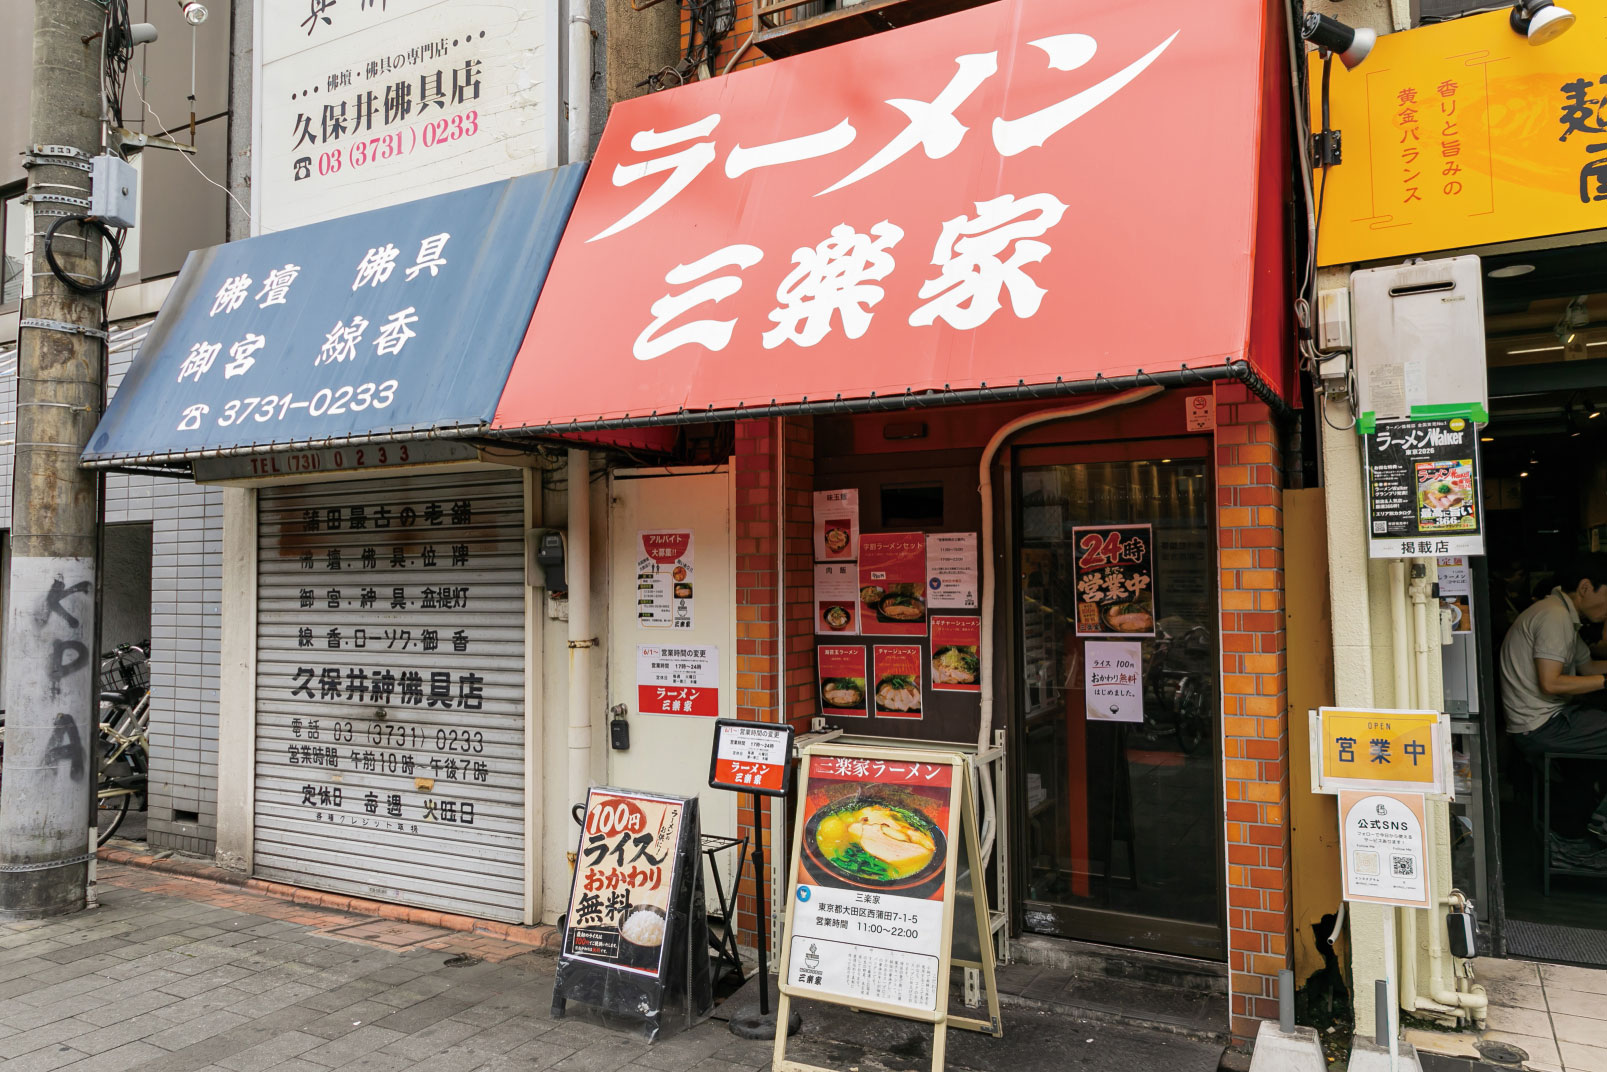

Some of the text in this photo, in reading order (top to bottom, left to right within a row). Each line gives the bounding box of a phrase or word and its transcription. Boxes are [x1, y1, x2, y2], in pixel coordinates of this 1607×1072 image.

[292, 59, 482, 151] 久保井佛具店
[584, 28, 1181, 243] ラーメン
[1397, 87, 1421, 203] 黄金バランス
[1437, 79, 1462, 196] 香りと旨みの
[632, 192, 1070, 361] 三楽家
[176, 306, 419, 384] 御宮 線香
[217, 379, 399, 429] 3731-0233
[1377, 427, 1463, 451] ラーメンWalker
[251, 456, 280, 475] TEL
[649, 535, 682, 544] アルバイト
[1079, 531, 1146, 568] 24時
[1401, 541, 1449, 554] 掲載店
[1077, 573, 1150, 603] 営業中
[661, 649, 706, 658] 営業時間の変更
[291, 666, 484, 710] 久保井神佛具店
[656, 688, 700, 700] ラーメン
[1094, 689, 1135, 697] はじめました。
[292, 718, 320, 740] 電話
[1367, 722, 1391, 731] OPEN
[288, 744, 338, 767] 営業時間
[1335, 737, 1425, 766] 営業中
[731, 761, 770, 775] ラーメン
[301, 785, 342, 807] 定休日
[590, 803, 640, 835] 100円
[1357, 819, 1408, 831] 公式SNS
[584, 832, 669, 868] ライス
[584, 865, 662, 891] おかわり
[575, 888, 633, 926] 無料
[856, 893, 880, 904] 三楽家
[818, 902, 918, 924] 東京都大田区西蒲田7-1-5
[816, 916, 918, 938] 営業時間 11:00～22:00
